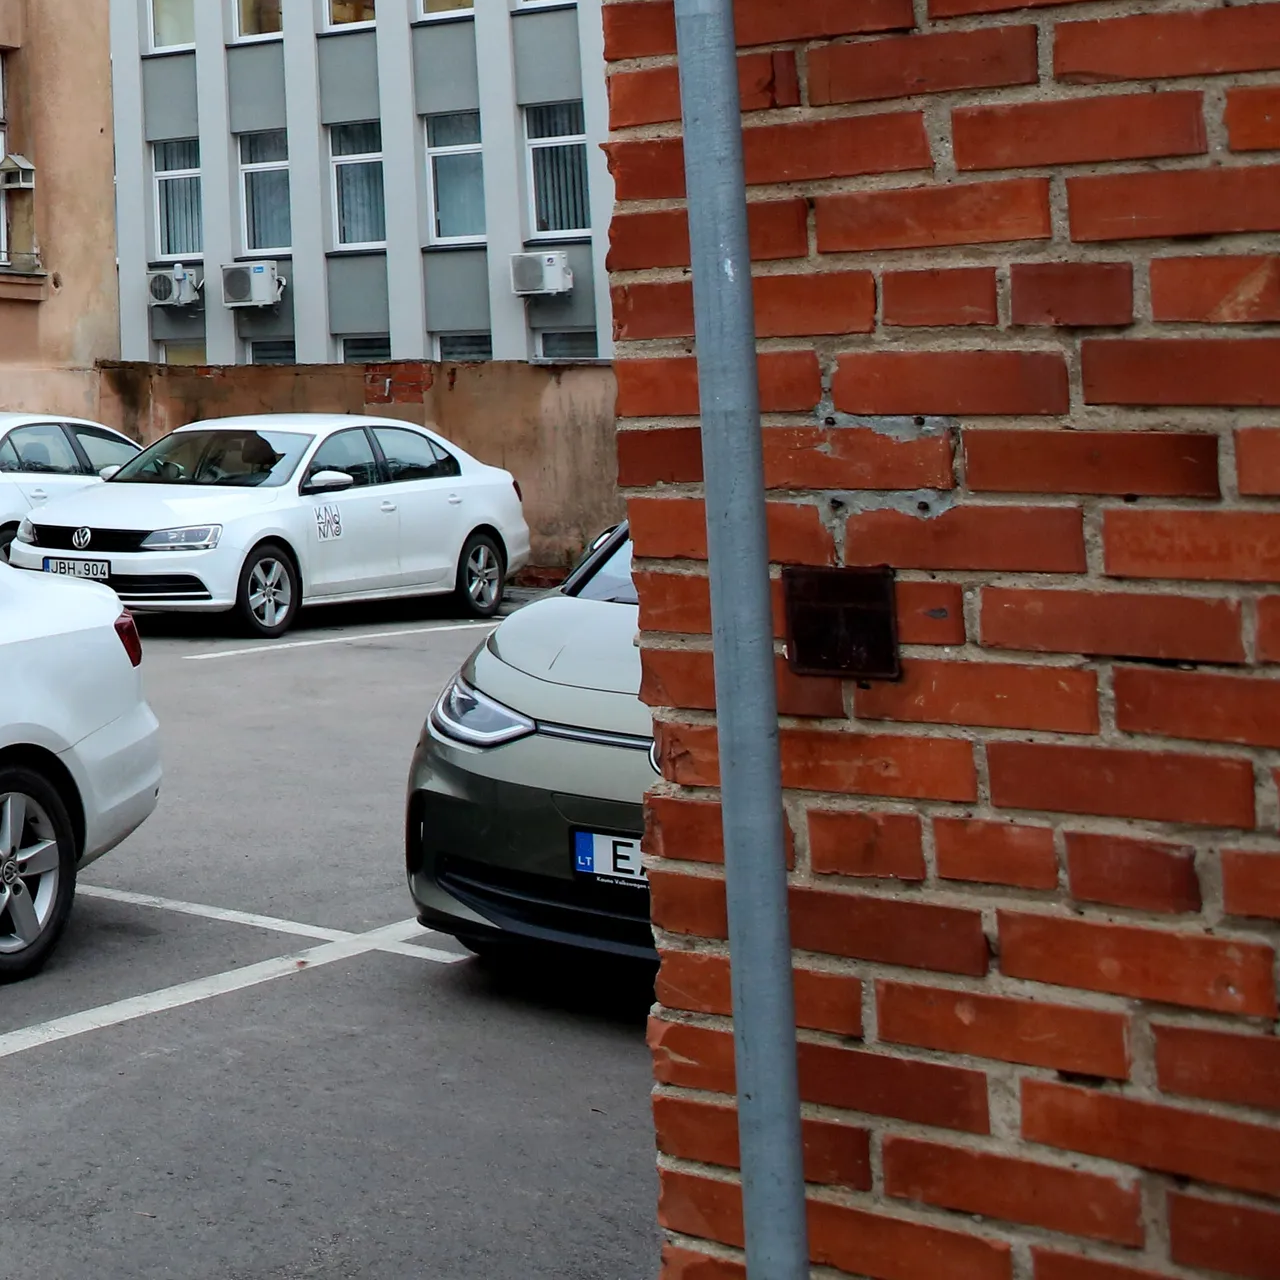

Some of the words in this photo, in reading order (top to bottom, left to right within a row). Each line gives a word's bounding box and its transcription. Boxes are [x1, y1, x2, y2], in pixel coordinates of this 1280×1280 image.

[51, 561, 76, 575] JBH
[83, 563, 106, 576] 904
[578, 856, 592, 866] LT
[612, 840, 647, 876] E
